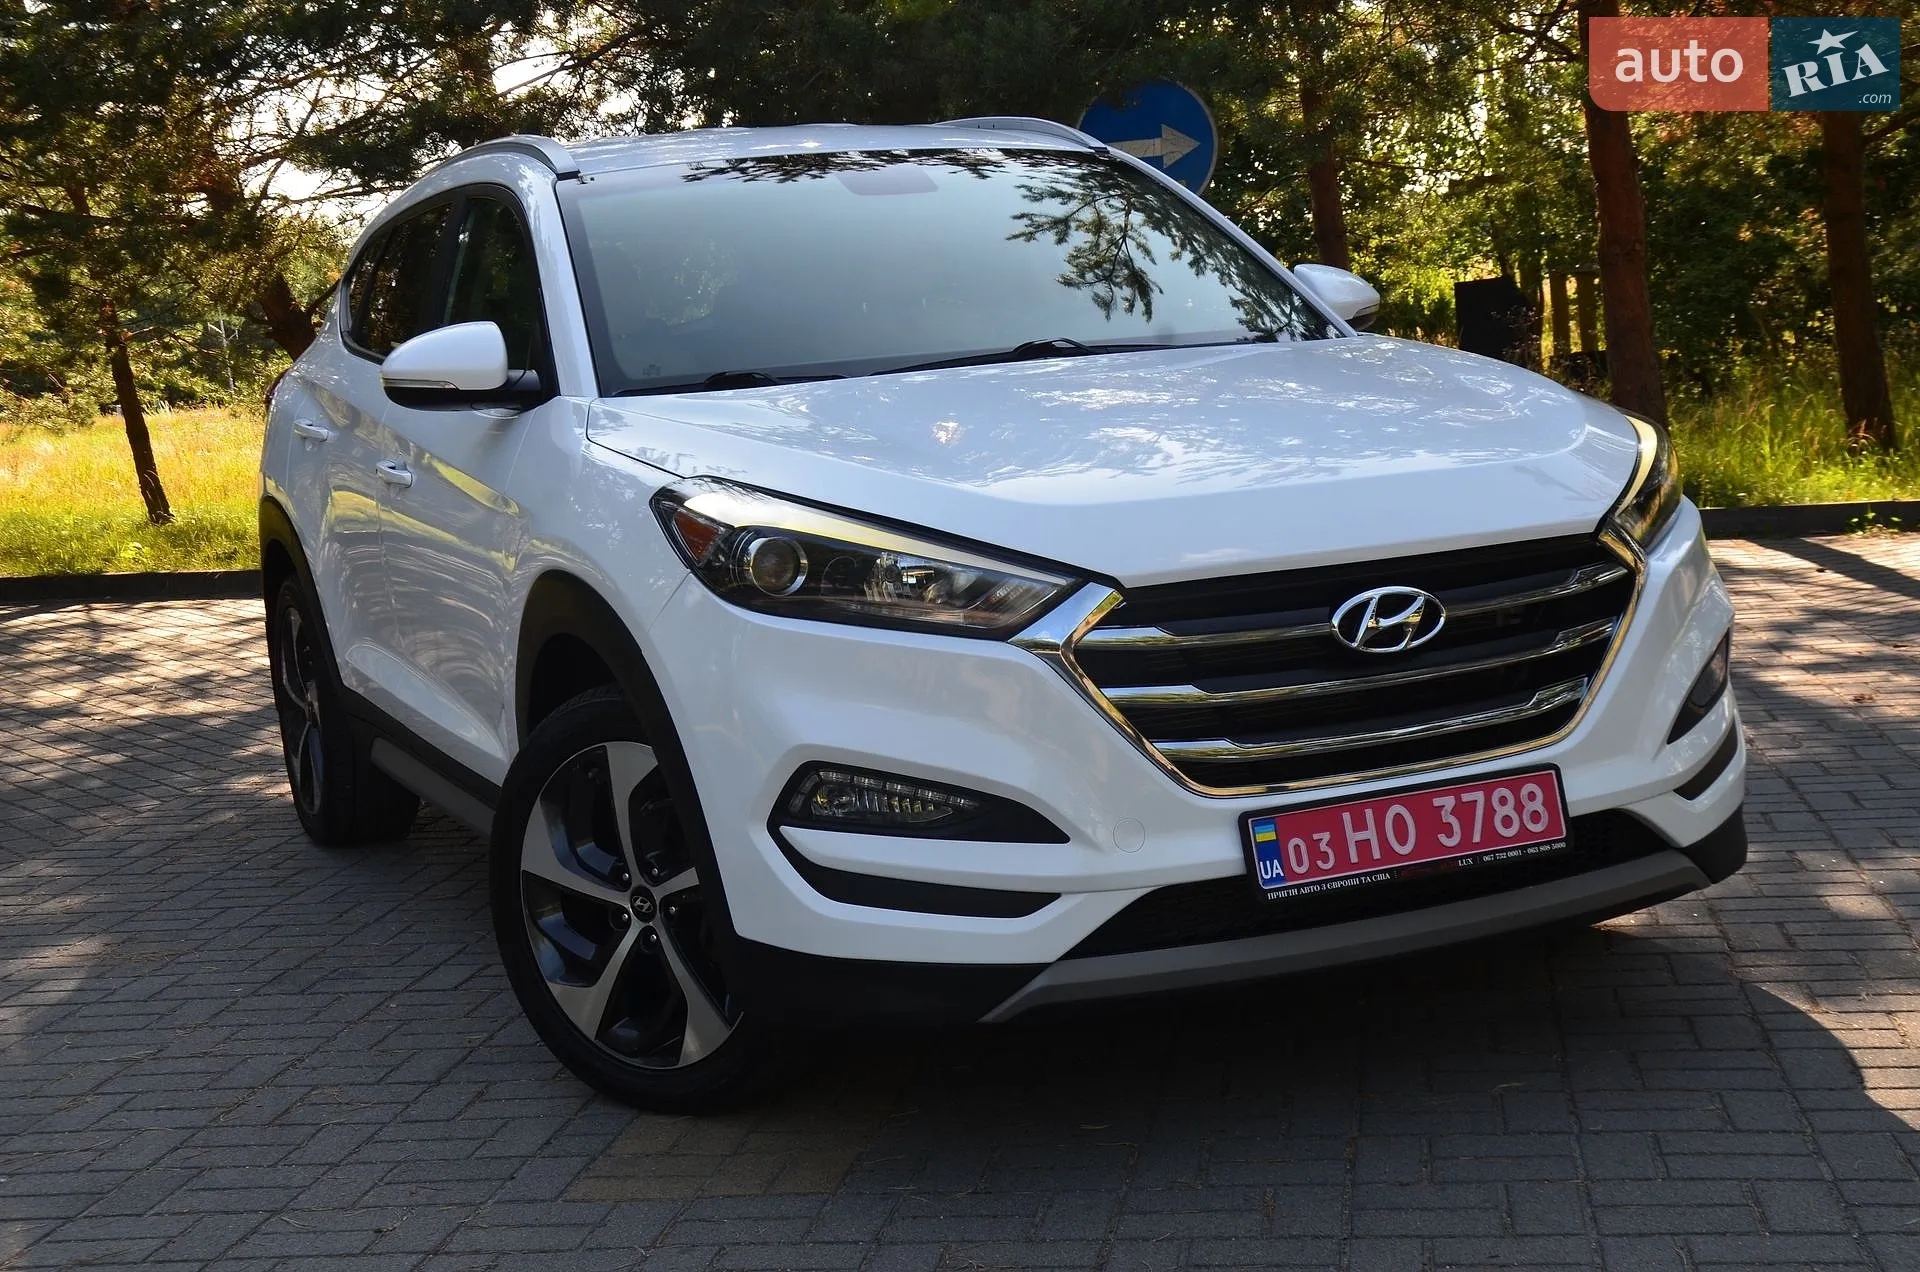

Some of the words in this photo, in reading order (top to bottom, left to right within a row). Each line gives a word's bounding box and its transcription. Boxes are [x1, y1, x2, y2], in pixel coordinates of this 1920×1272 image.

[1287, 831, 1336, 875] 03
[1432, 783, 1549, 848] 3788
[1259, 859, 1285, 880] UA
[1458, 857, 1474, 867] LUX
[1299, 885, 1320, 895] АВТО
[1327, 877, 1360, 890] ЄВРОПИ
[1360, 875, 1372, 884] ТА
[1372, 872, 1391, 882] США
